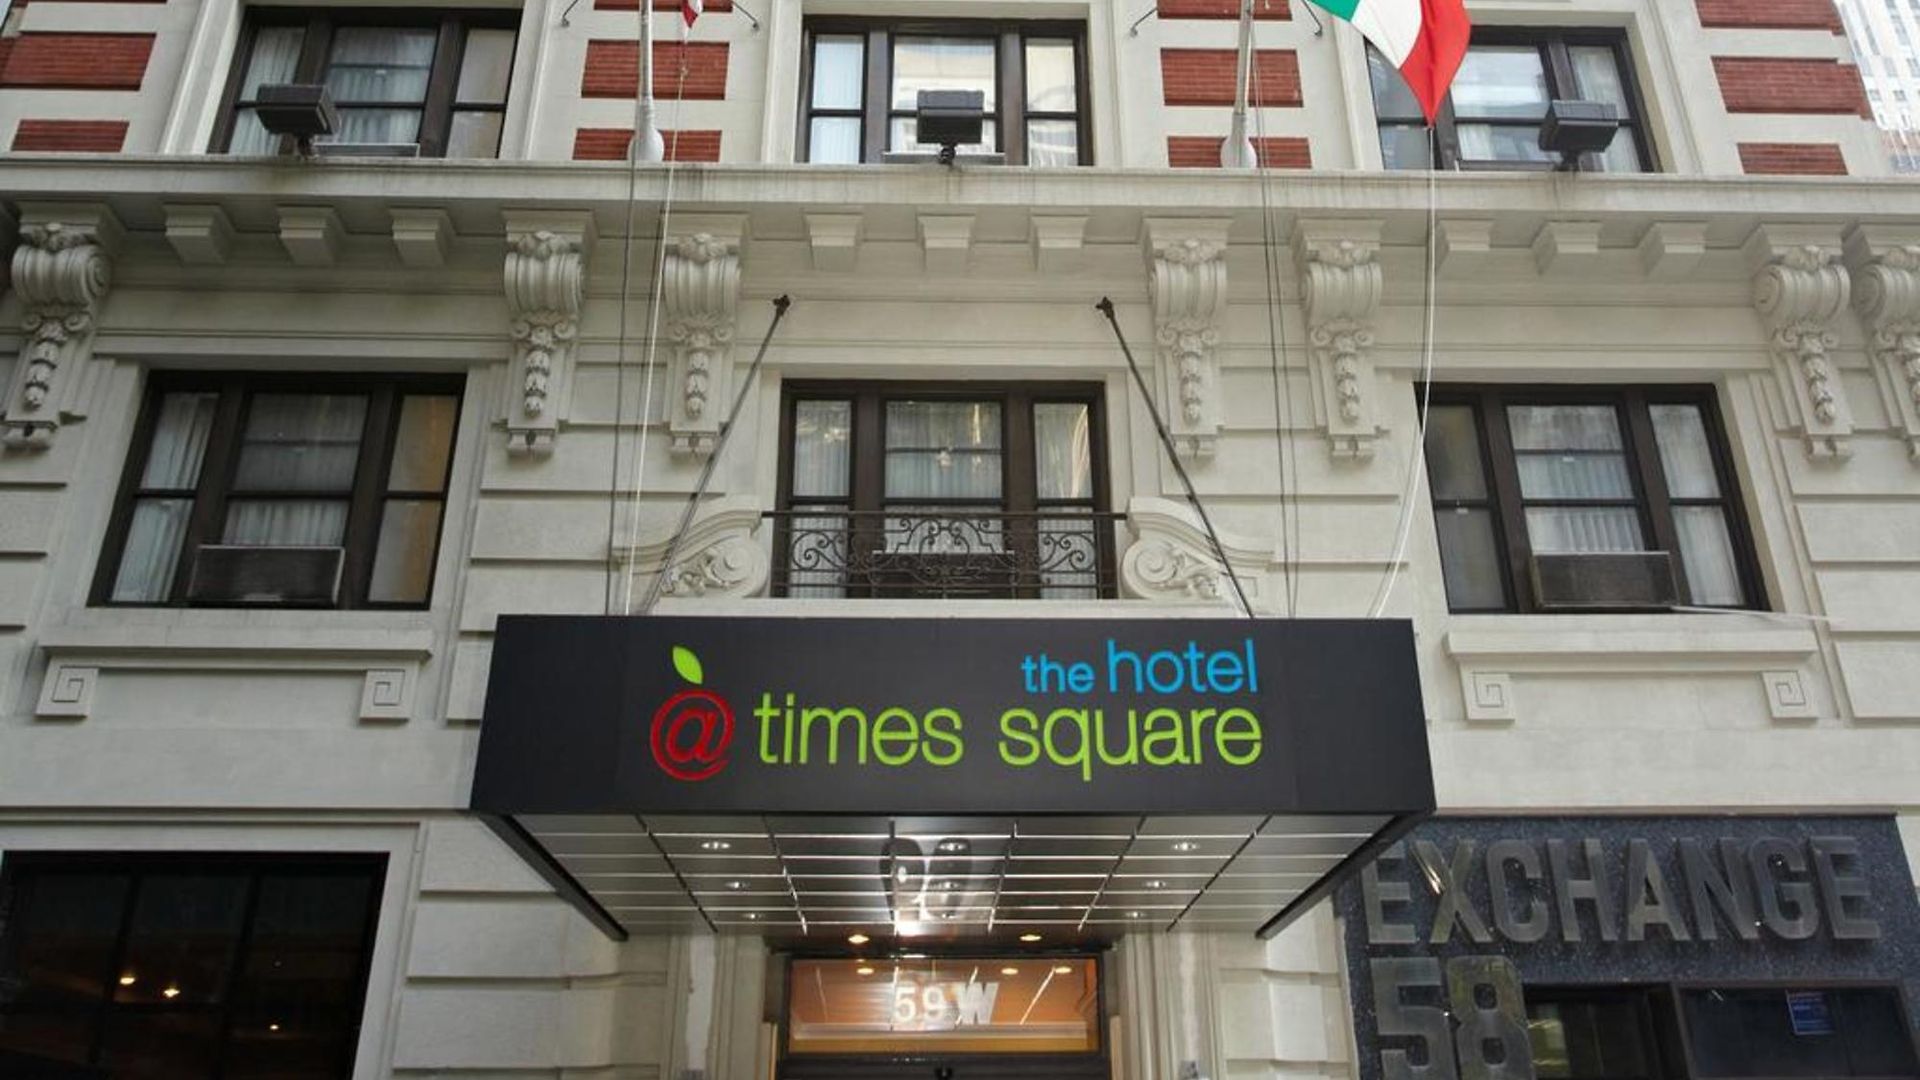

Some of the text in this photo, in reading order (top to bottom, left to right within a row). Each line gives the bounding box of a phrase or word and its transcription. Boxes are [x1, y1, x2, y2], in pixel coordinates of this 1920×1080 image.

[1020, 638, 1258, 693] the hotel
[754, 692, 963, 765] times
[999, 707, 1262, 782] square
[1361, 835, 1881, 944] EXCHANGE
[1369, 954, 1537, 1080] 58
